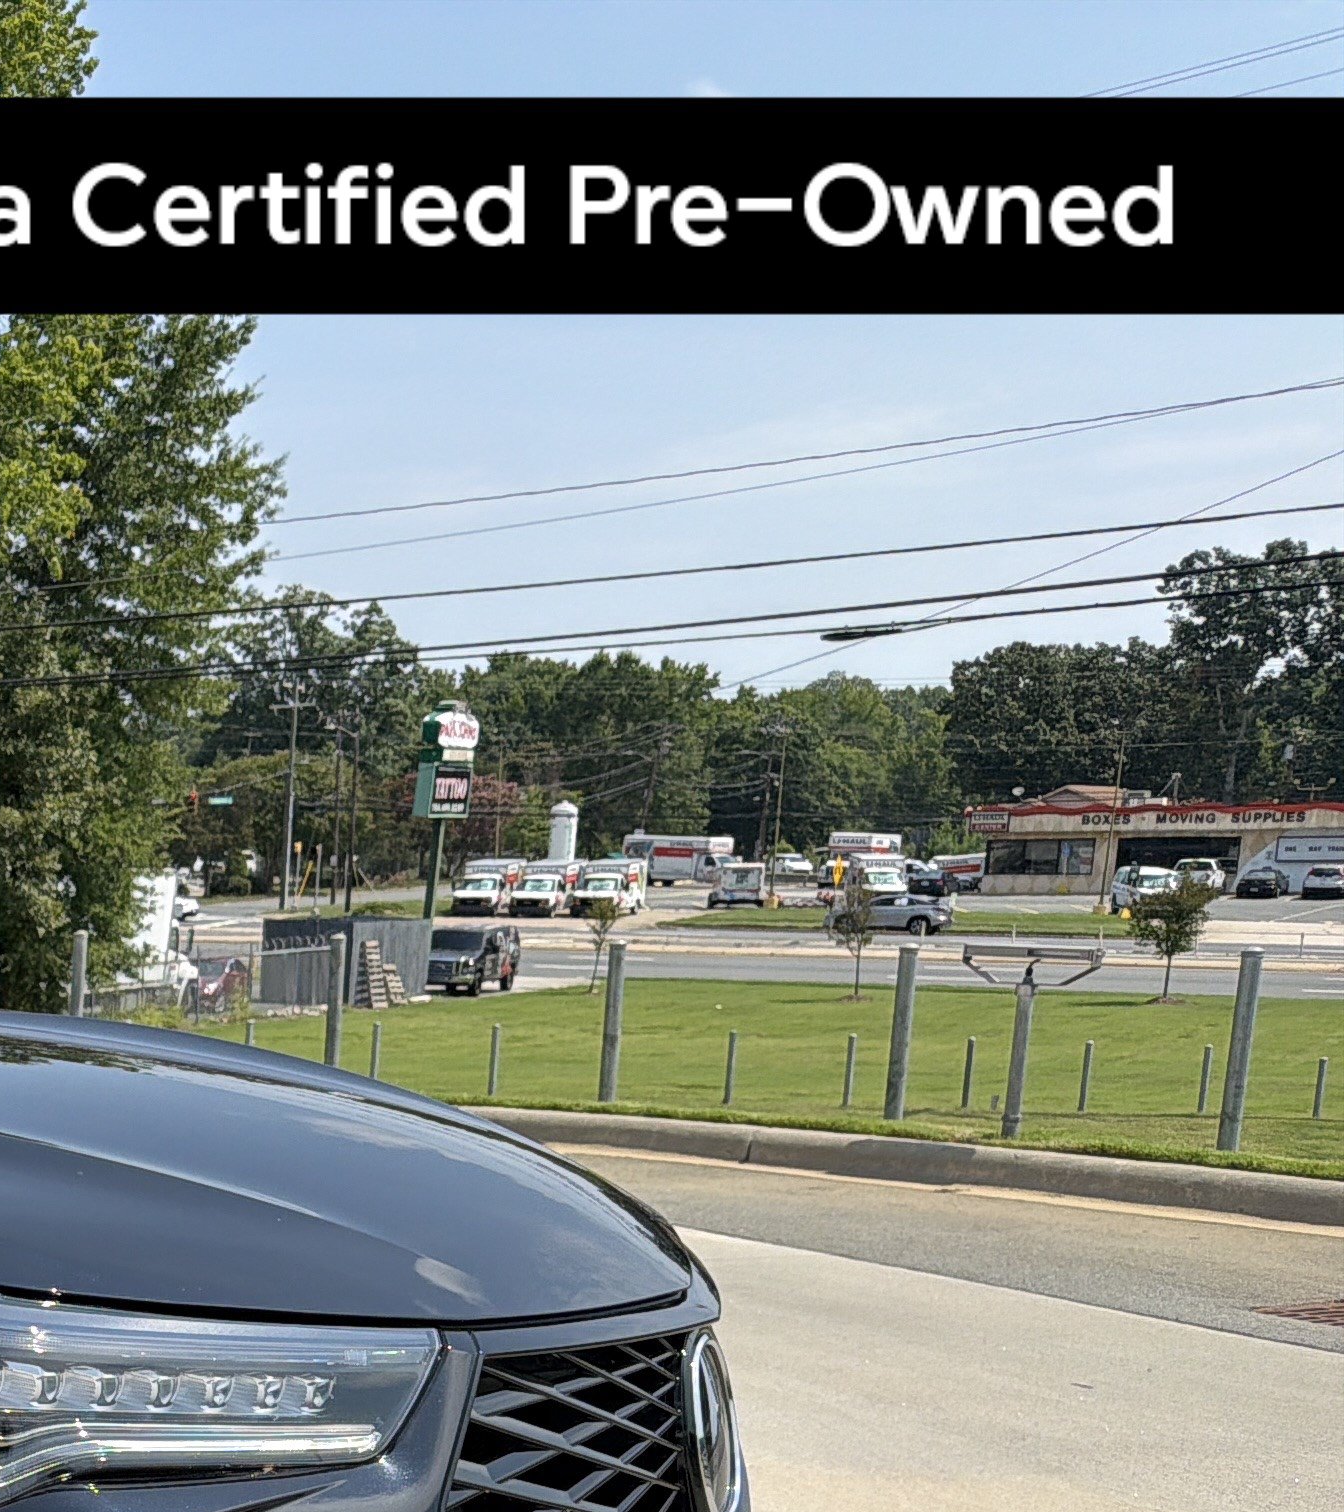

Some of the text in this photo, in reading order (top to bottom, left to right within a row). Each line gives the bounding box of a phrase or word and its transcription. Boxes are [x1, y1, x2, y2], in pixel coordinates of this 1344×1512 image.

[435, 778, 468, 800] TATTOO
[1082, 811, 1306, 826] BOXES MOVING SUPPLIES
